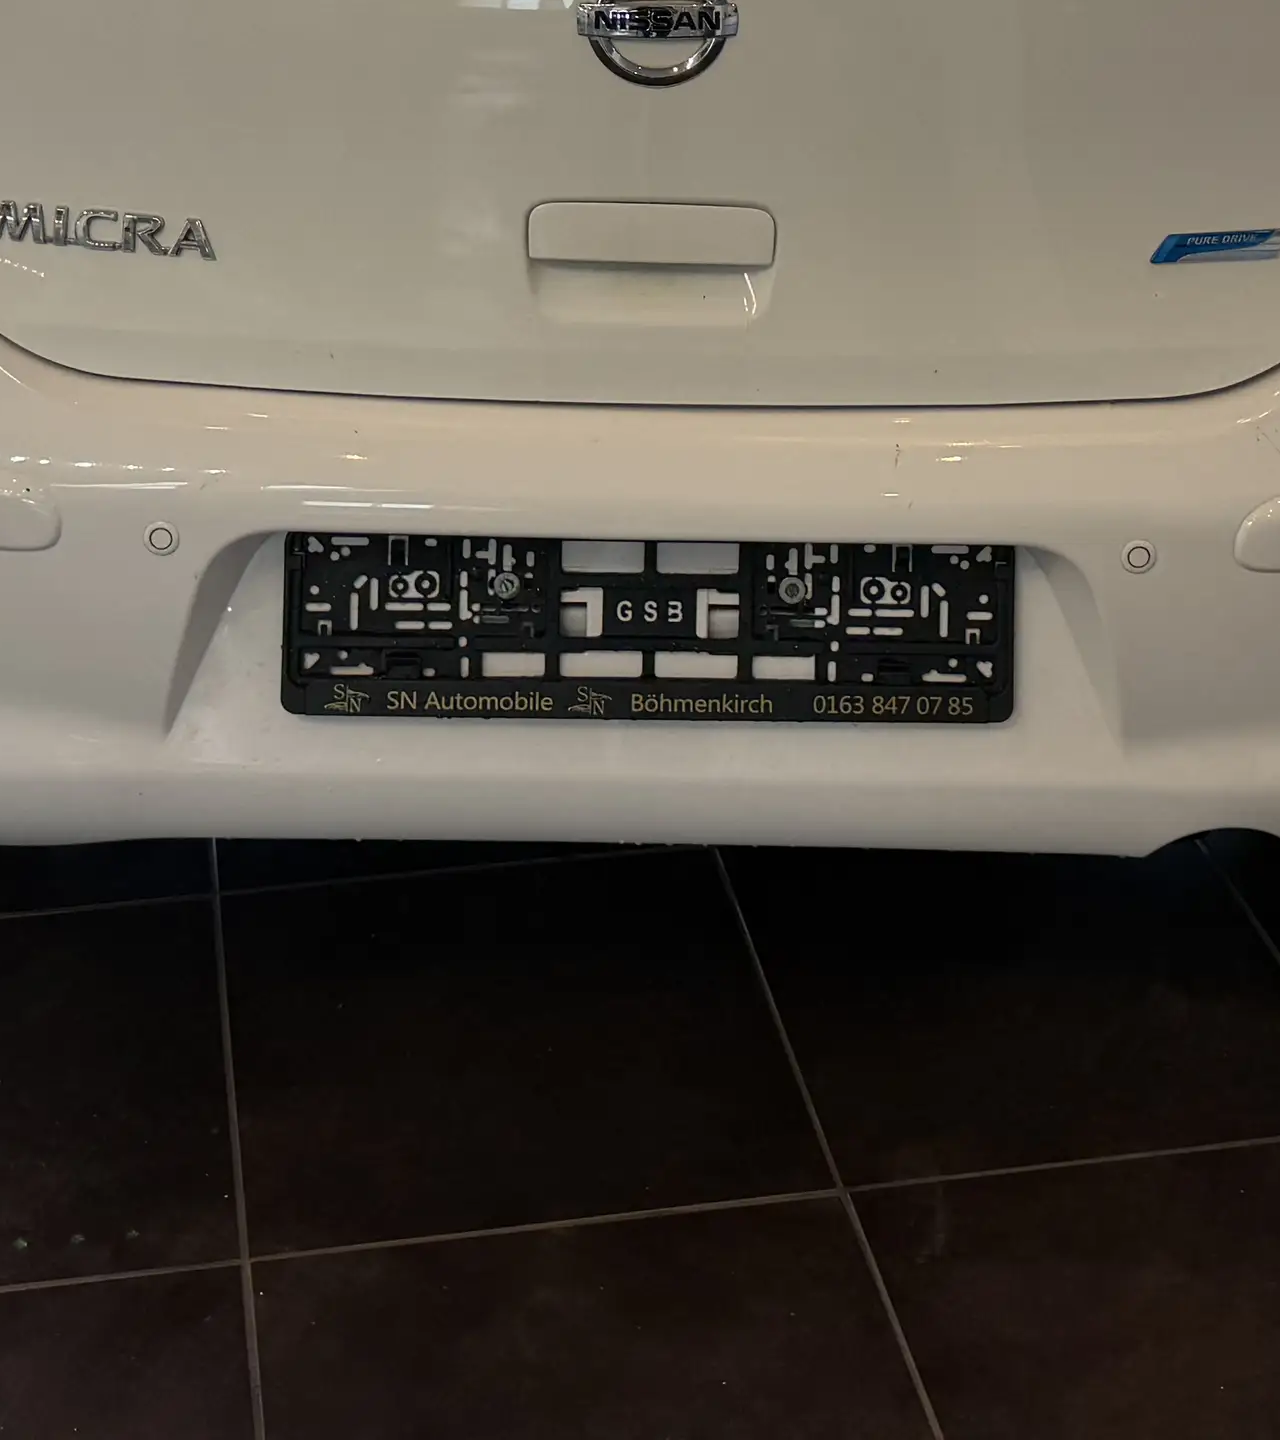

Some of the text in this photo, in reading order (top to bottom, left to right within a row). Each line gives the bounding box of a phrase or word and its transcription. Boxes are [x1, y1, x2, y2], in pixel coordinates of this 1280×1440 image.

[593, 9, 722, 32] NISSAN
[1186, 233, 1260, 246] PURE DRIVE
[386, 690, 554, 712] SN Automobile
[630, 693, 774, 715] Böhmenkirch
[813, 695, 974, 716] 0163 847 07 85
